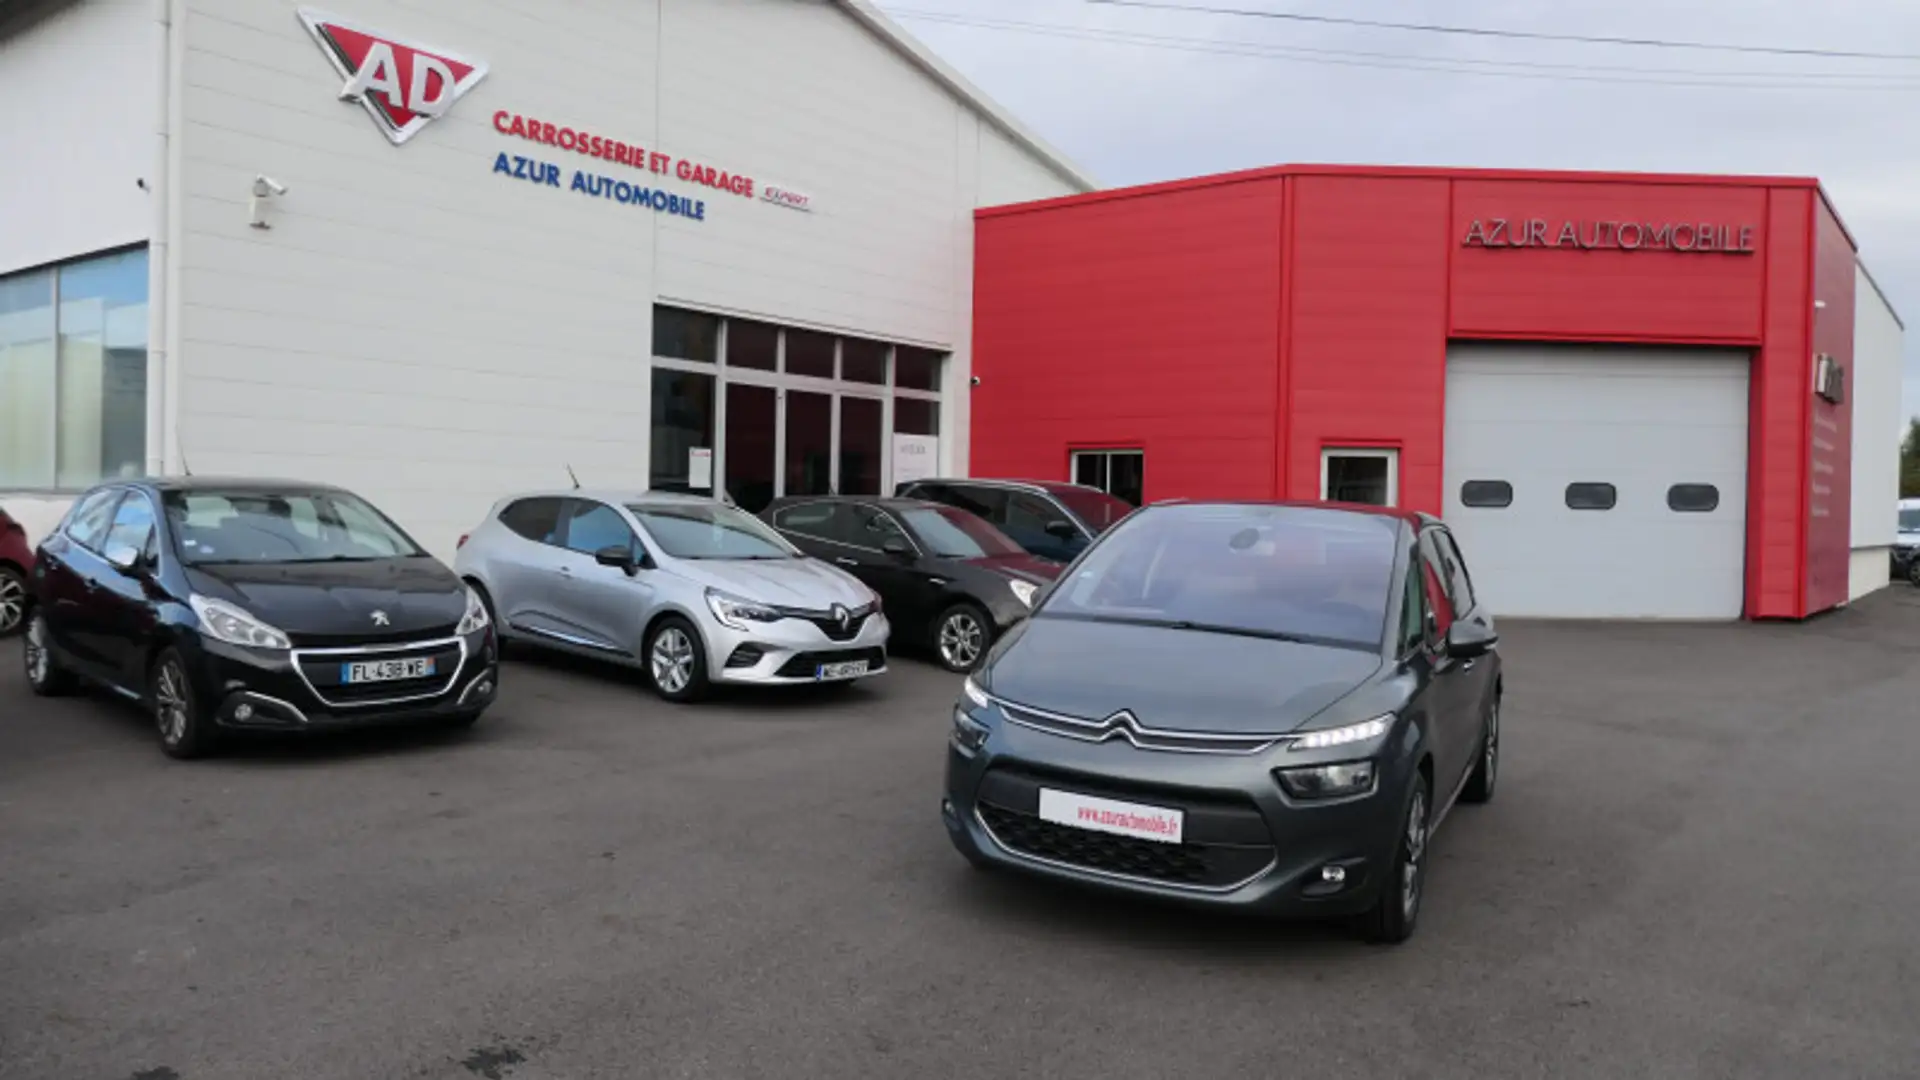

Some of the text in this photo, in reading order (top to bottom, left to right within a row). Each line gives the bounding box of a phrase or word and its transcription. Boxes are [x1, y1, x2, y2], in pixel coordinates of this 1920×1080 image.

[341, 42, 455, 118] AD
[493, 110, 754, 198] CARROSSERIE ET GARAGE
[493, 152, 705, 221] AZUR AUTOMOBILE
[1464, 218, 1755, 252] AZUR AUTOMOBILE
